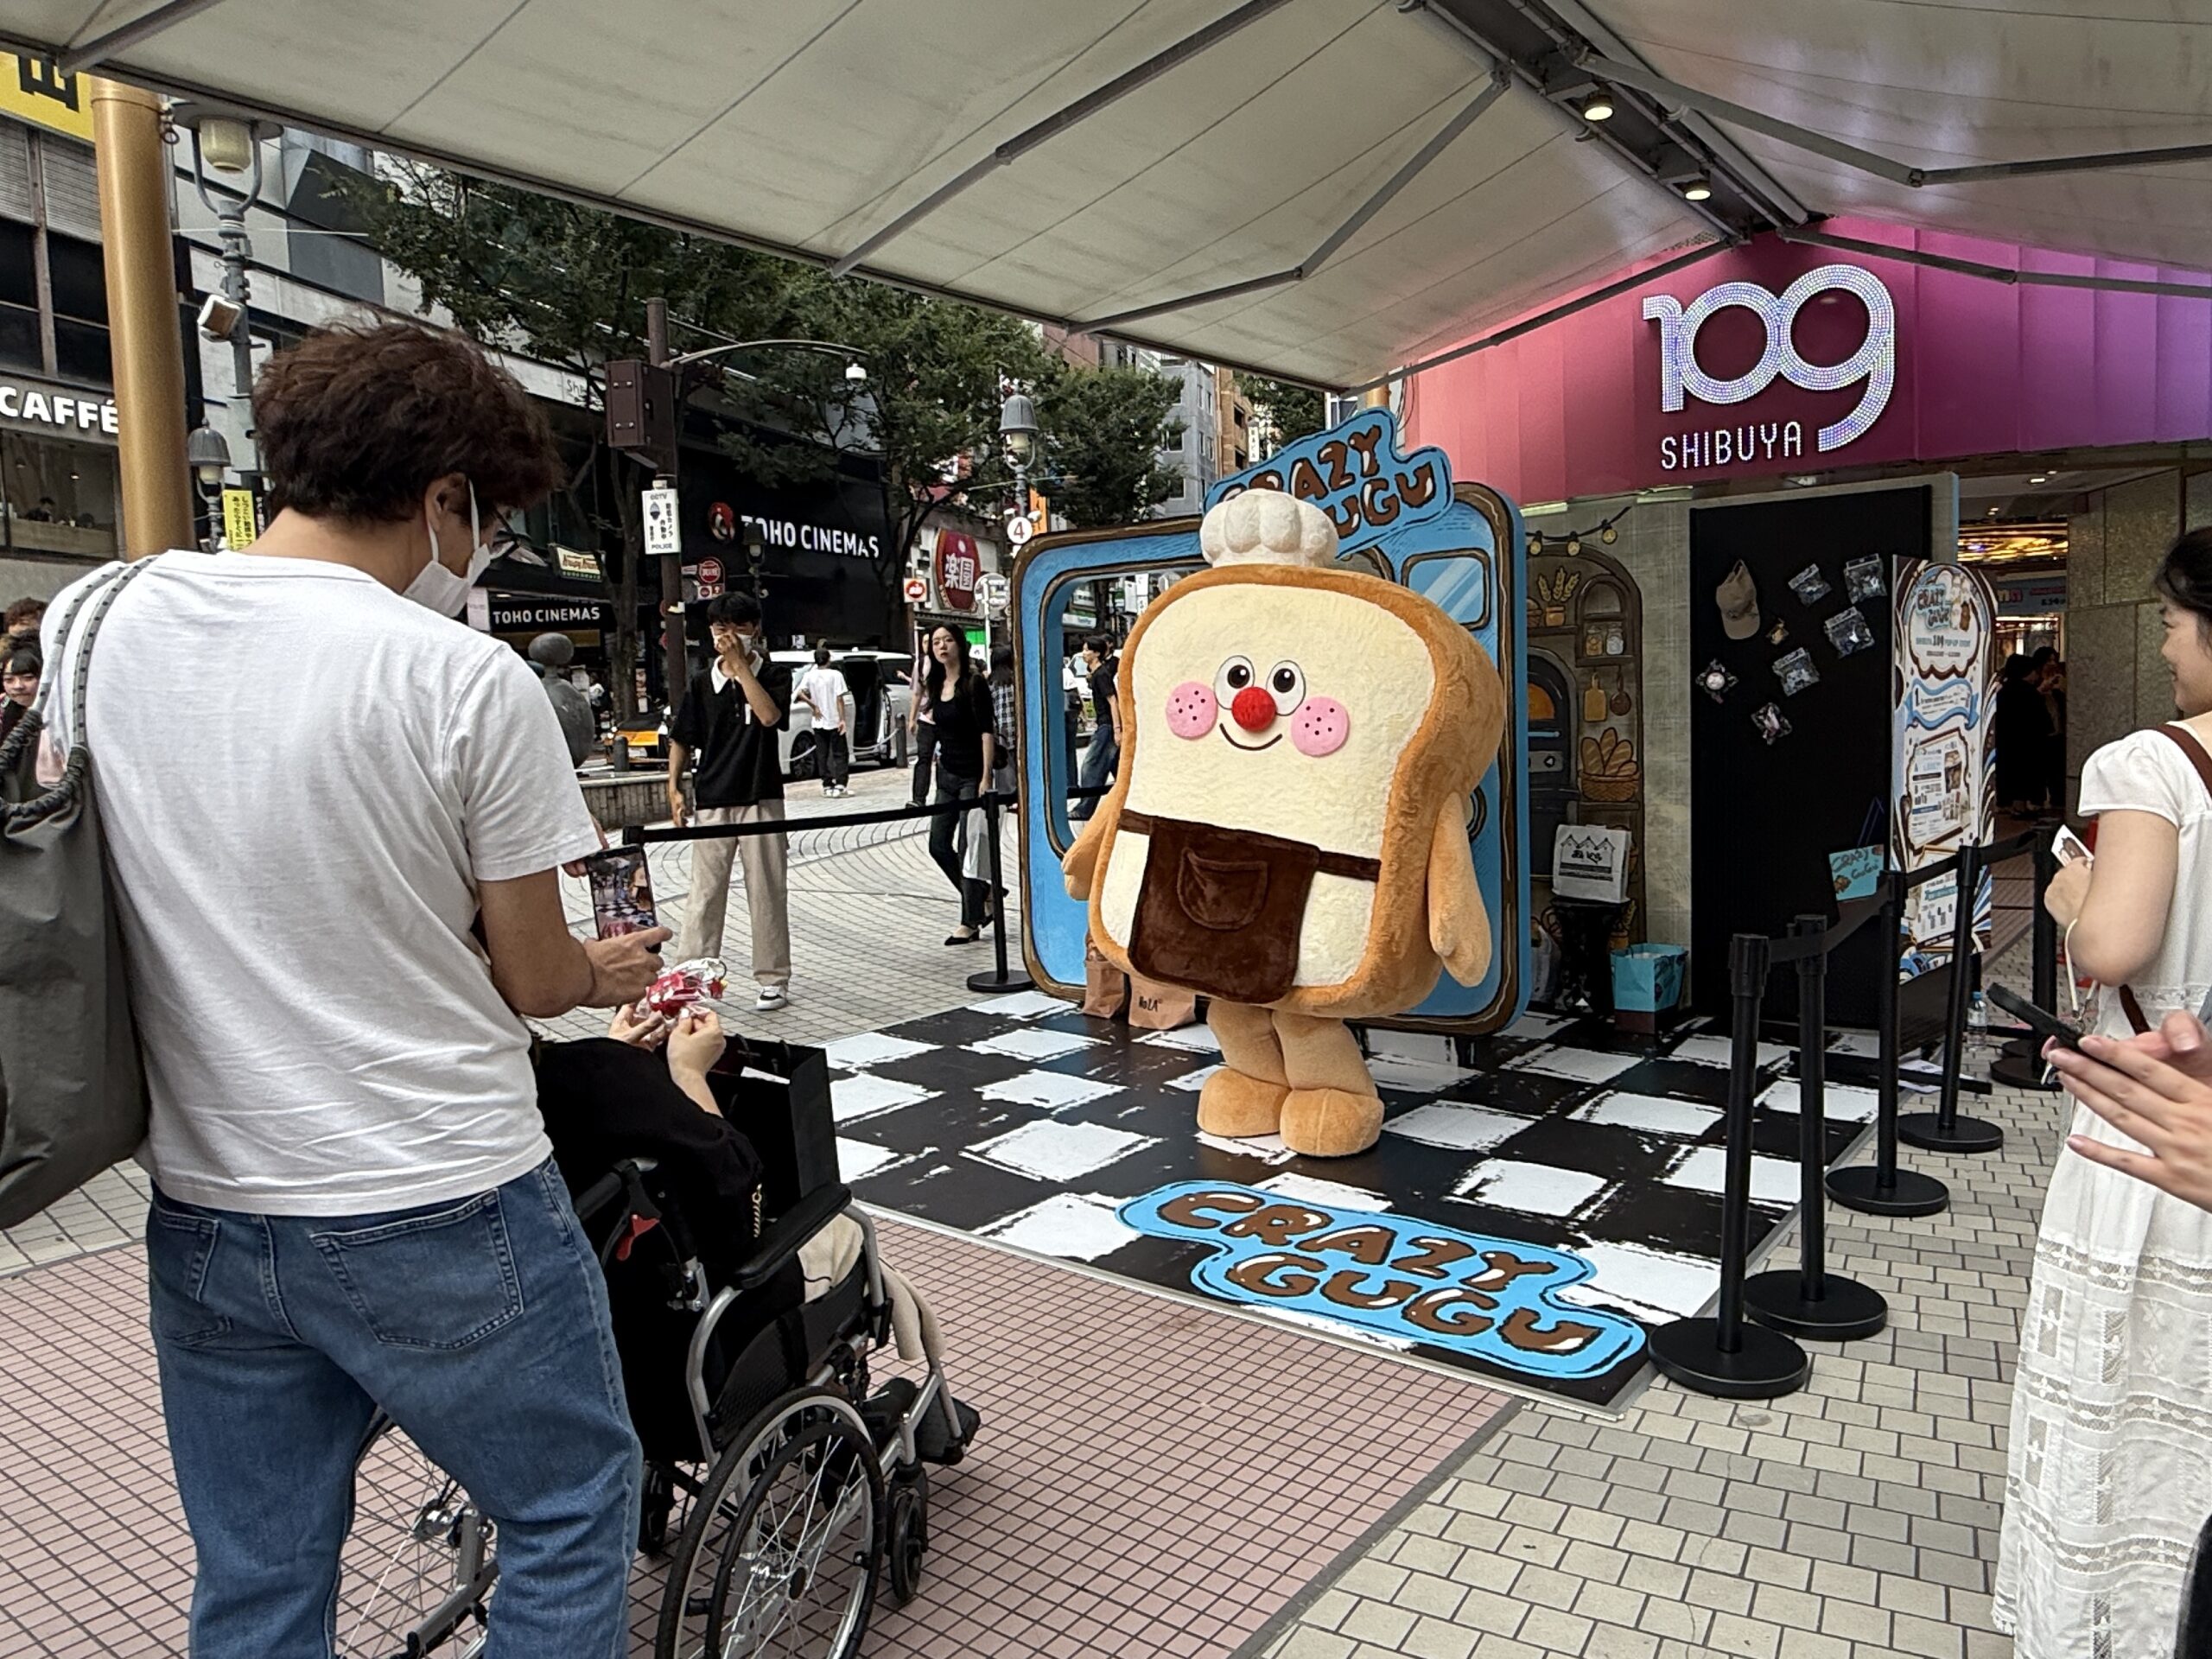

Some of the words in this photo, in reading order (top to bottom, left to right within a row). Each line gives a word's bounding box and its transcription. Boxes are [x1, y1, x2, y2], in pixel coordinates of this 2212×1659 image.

[1643, 264, 1895, 452] 109
[1218, 424, 1382, 505] AZY
[1662, 421, 1802, 469] SHIBUYA
[1014, 521, 1025, 539] 4
[1324, 461, 1437, 539] UGU
[800, 524, 880, 558] CINEMAS
[944, 553, 975, 592] 楽園
[493, 609, 532, 625] TOHO
[535, 607, 601, 622] CINEMAS
[1156, 1192, 1560, 1292] CRAZY
[1224, 1252, 1605, 1356] GUGU
